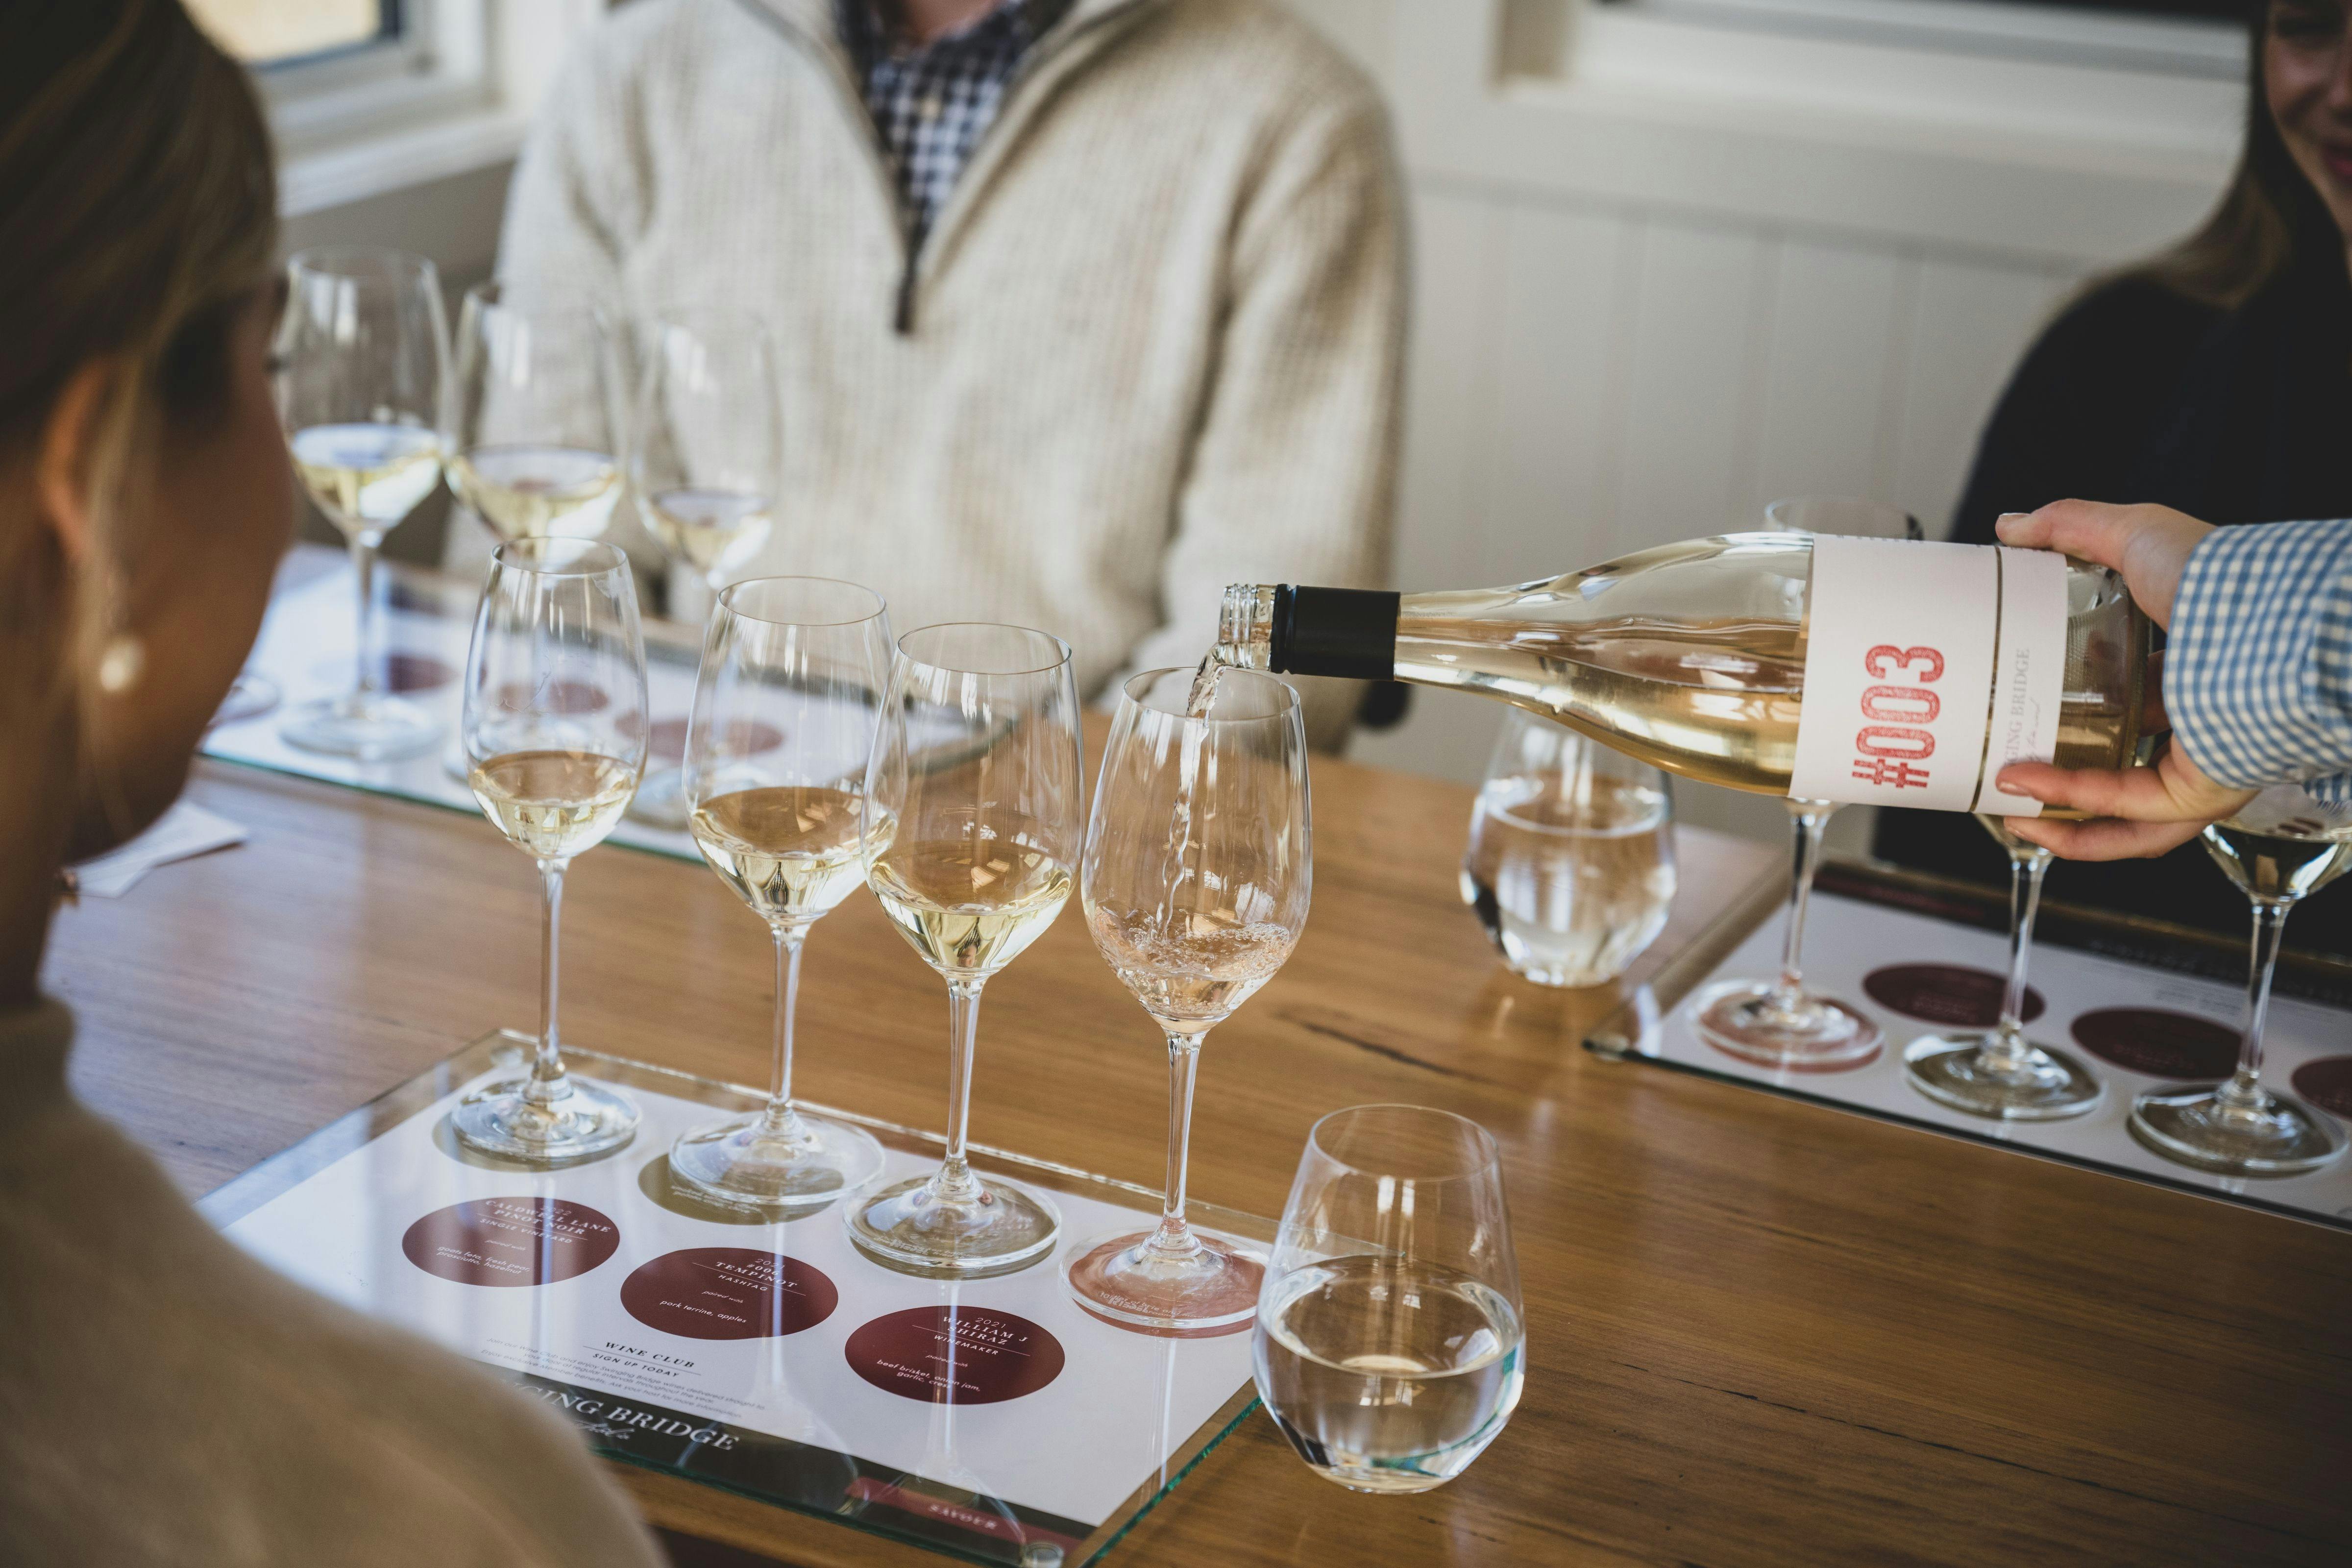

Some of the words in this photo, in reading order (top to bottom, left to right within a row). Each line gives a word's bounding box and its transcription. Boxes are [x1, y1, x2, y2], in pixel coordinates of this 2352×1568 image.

[2011, 648, 2030, 716] BRIDGE
[1852, 644, 1944, 788] #003
[486, 1200, 564, 1223] CALDWELL
[570, 1220, 612, 1233] LANE
[493, 1209, 542, 1225] PINOT
[548, 1222, 586, 1235] NOIR
[480, 1218, 518, 1231] SINGLE
[520, 1228, 572, 1244] VINEYARD
[436, 1251, 481, 1266] prosciutto,
[484, 1262, 521, 1274] hazelnut
[437, 1246, 463, 1255] goats
[464, 1251, 483, 1261] feta,
[486, 1257, 507, 1266] fresh
[508, 1263, 531, 1272] pear,
[746, 1264, 780, 1275] #006
[755, 1258, 785, 1270] 2021
[715, 1262, 798, 1288] TEMPINOT
[718, 1274, 768, 1291] HASHTAG
[701, 1290, 729, 1298] paired
[660, 1300, 682, 1308] pork
[683, 1305, 713, 1316] terrine,
[717, 1313, 747, 1323] apples
[1141, 1301, 1160, 1311] brie
[943, 1317, 1014, 1339] WILLIAM
[975, 1317, 1006, 1328] 2021
[934, 1335, 999, 1355] WINEMAKER
[948, 1326, 1008, 1345] SHIRAZ
[592, 1353, 621, 1363] SIGN
[641, 1365, 680, 1377] TODAY
[605, 1342, 647, 1356] WINE
[652, 1353, 695, 1368] CLUB
[926, 1354, 953, 1363] paired
[877, 1359, 900, 1369] beef
[899, 1365, 931, 1379] brisket,
[934, 1376, 960, 1386] onion
[960, 1382, 980, 1392] jam,
[896, 1372, 925, 1383] garlic,
[929, 1380, 951, 1389] cress
[604, 1405, 739, 1451] BRIDGE
[929, 1504, 998, 1530] SAVOUR
